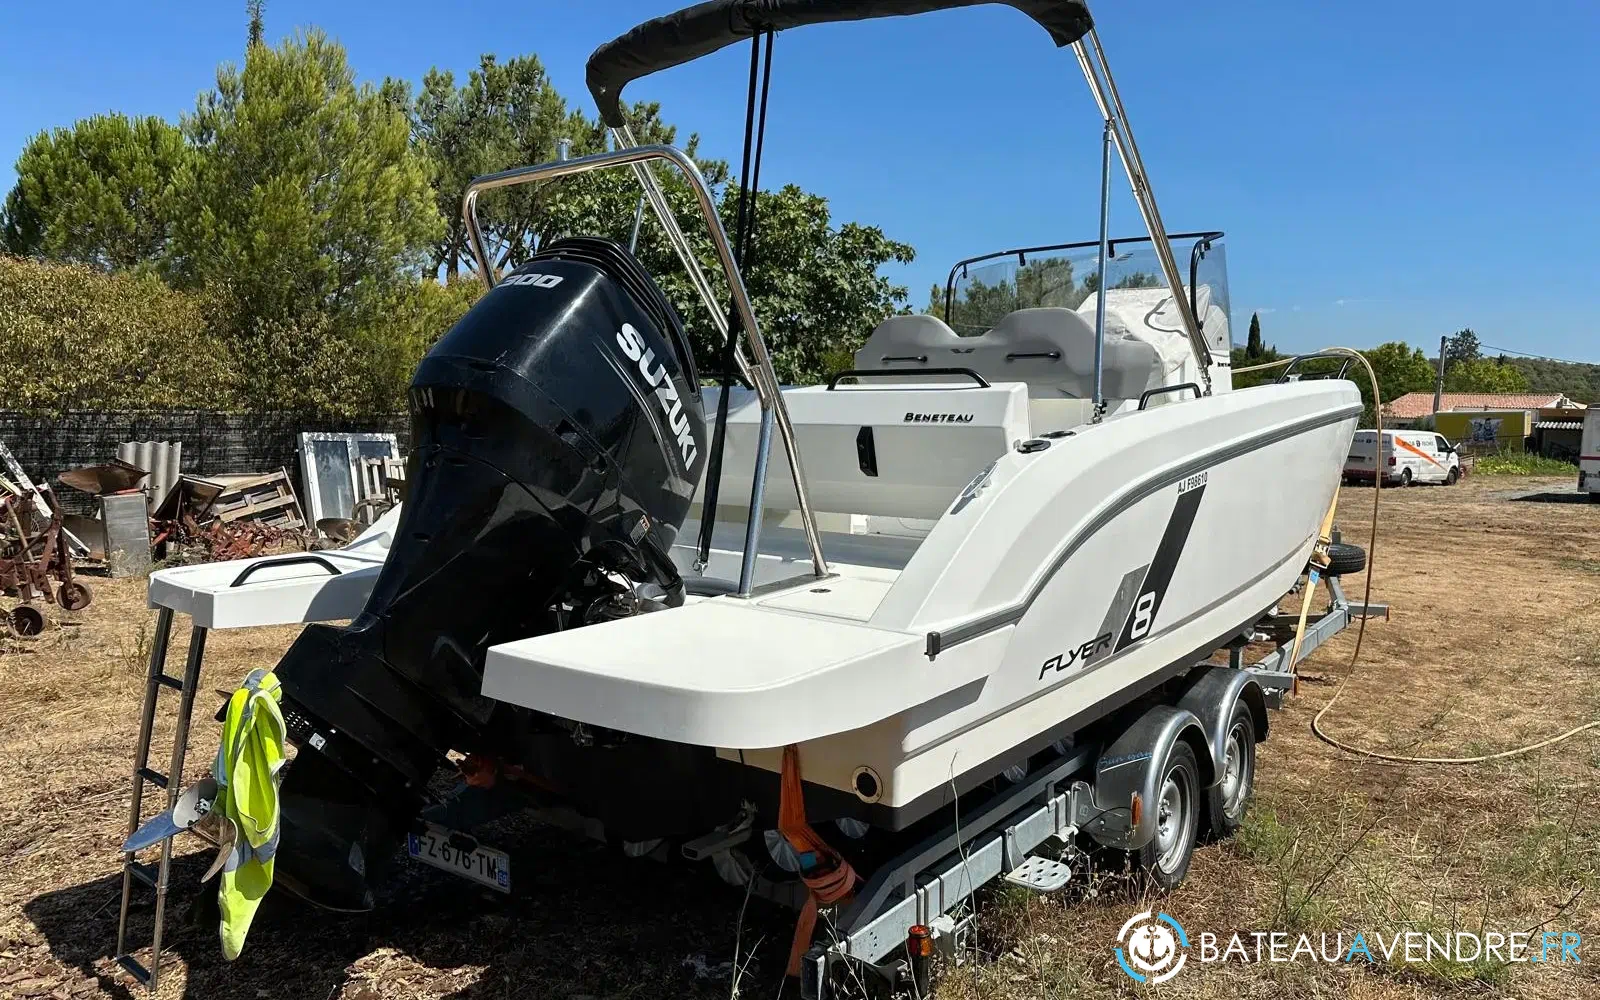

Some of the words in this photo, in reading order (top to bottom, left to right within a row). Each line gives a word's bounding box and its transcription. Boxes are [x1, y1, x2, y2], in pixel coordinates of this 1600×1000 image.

[616, 322, 697, 471] SUZUKI
[1177, 480, 1186, 494] AJ
[1039, 632, 1112, 680] FLYER
[1131, 591, 1155, 640] 8
